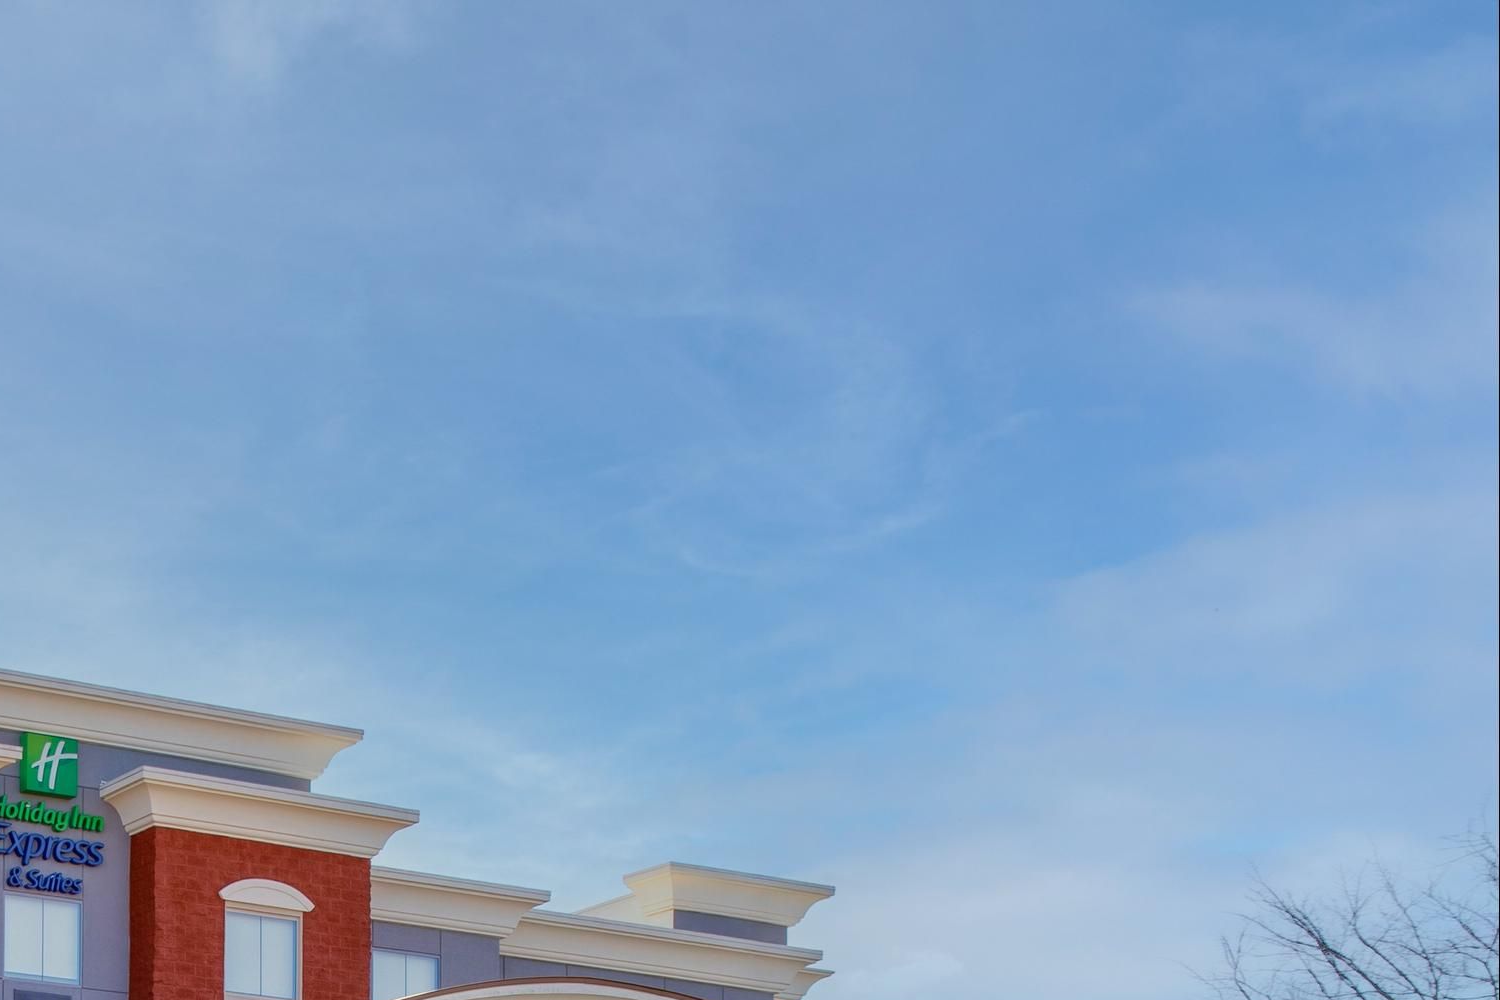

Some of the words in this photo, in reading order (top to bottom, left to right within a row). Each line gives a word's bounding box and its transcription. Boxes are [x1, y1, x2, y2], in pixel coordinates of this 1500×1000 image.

[71, 805, 105, 832] Inn
[6, 866, 23, 888] &
[24, 868, 83, 895] Suites
